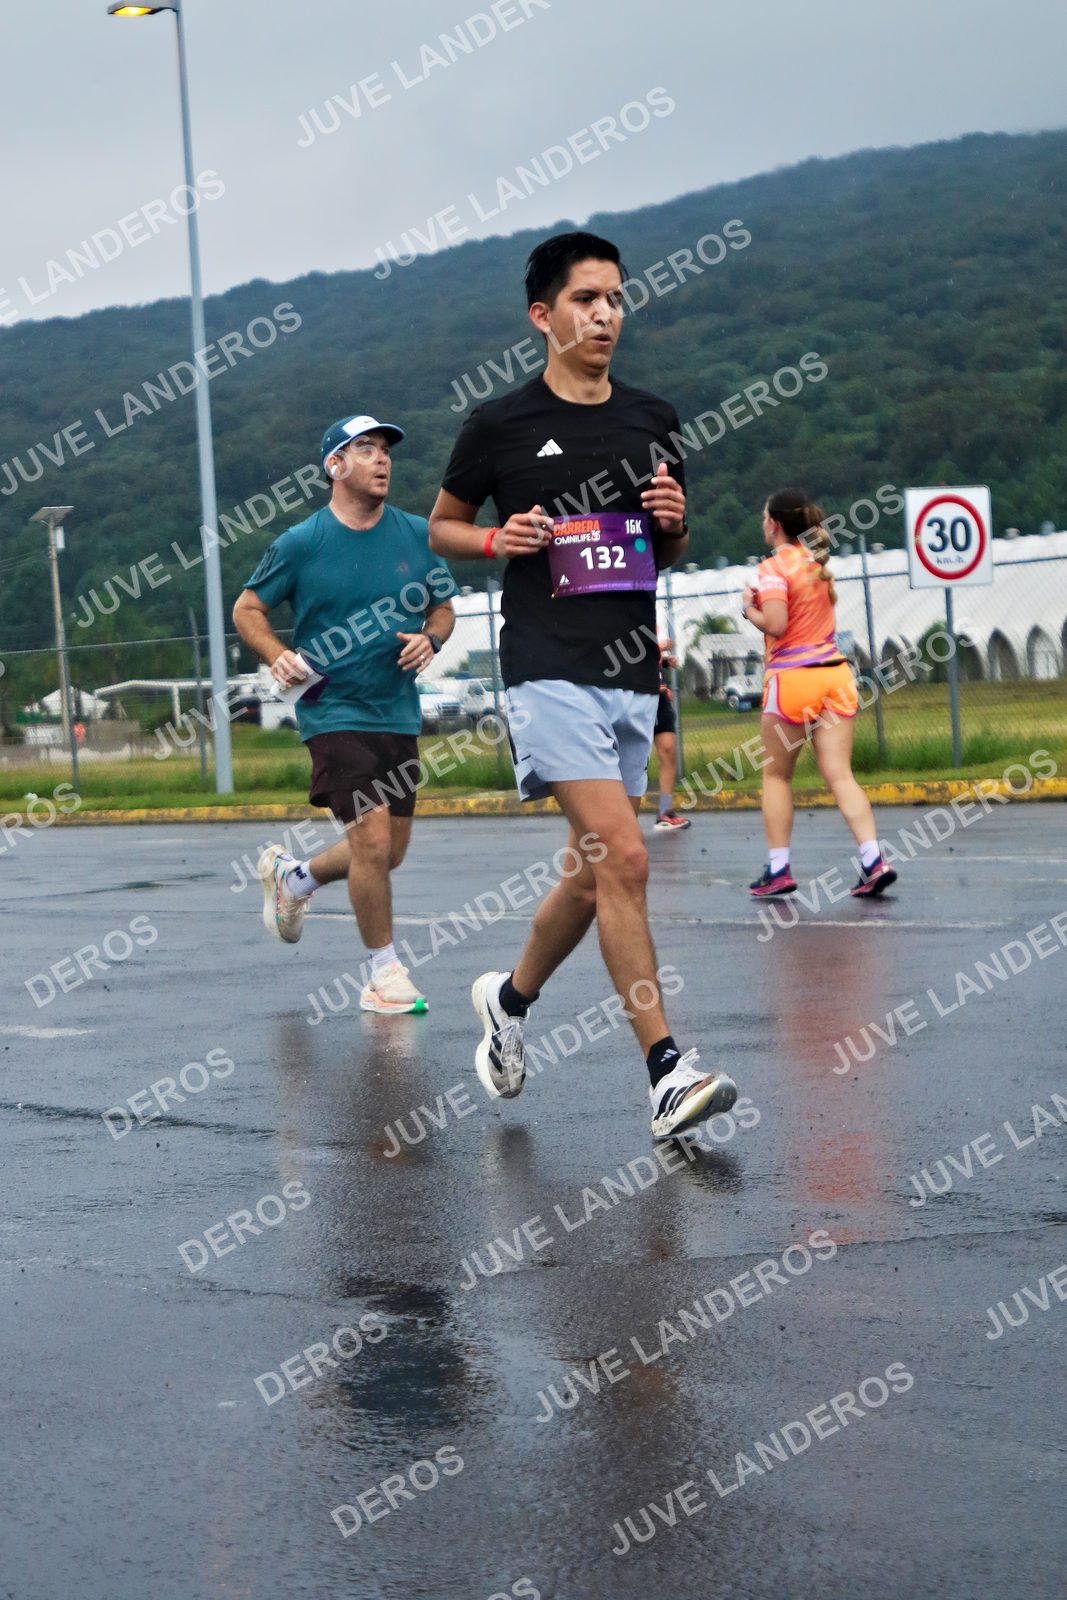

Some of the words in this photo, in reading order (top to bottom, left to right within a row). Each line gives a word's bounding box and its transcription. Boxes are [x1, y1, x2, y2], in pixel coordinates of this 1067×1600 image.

[553, 519, 600, 537] CARRERA
[554, 532, 591, 545] OMNILIFE
[927, 516, 972, 552] 30
[580, 545, 627, 570] 132
